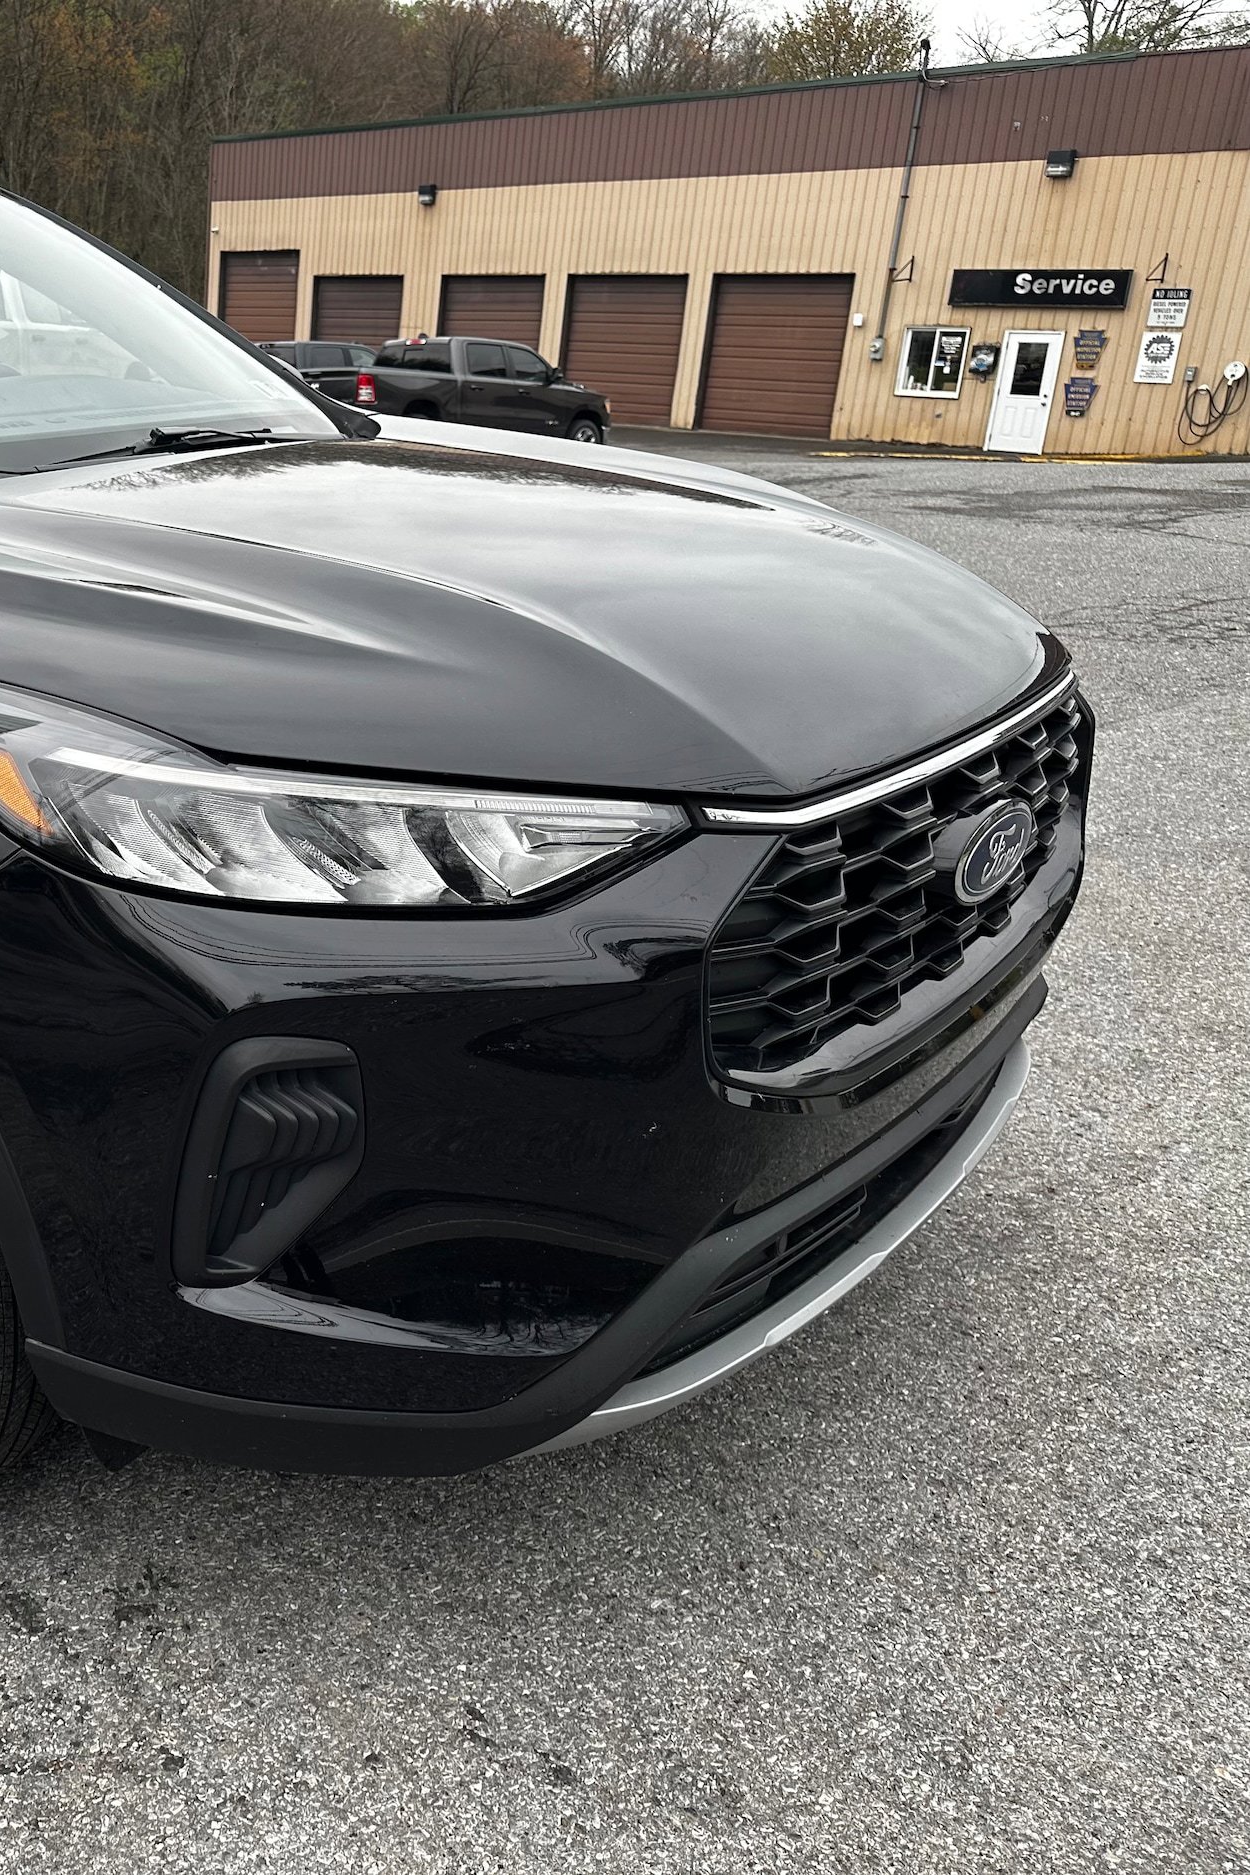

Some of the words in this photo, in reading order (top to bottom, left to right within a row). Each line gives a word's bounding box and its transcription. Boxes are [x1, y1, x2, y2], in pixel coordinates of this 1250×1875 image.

[1013, 272, 1116, 295] Service
[1155, 290, 1165, 299] NO
[1166, 290, 1189, 299] IDLING
[1148, 343, 1171, 354] ASE
[980, 822, 1025, 885] Ford
